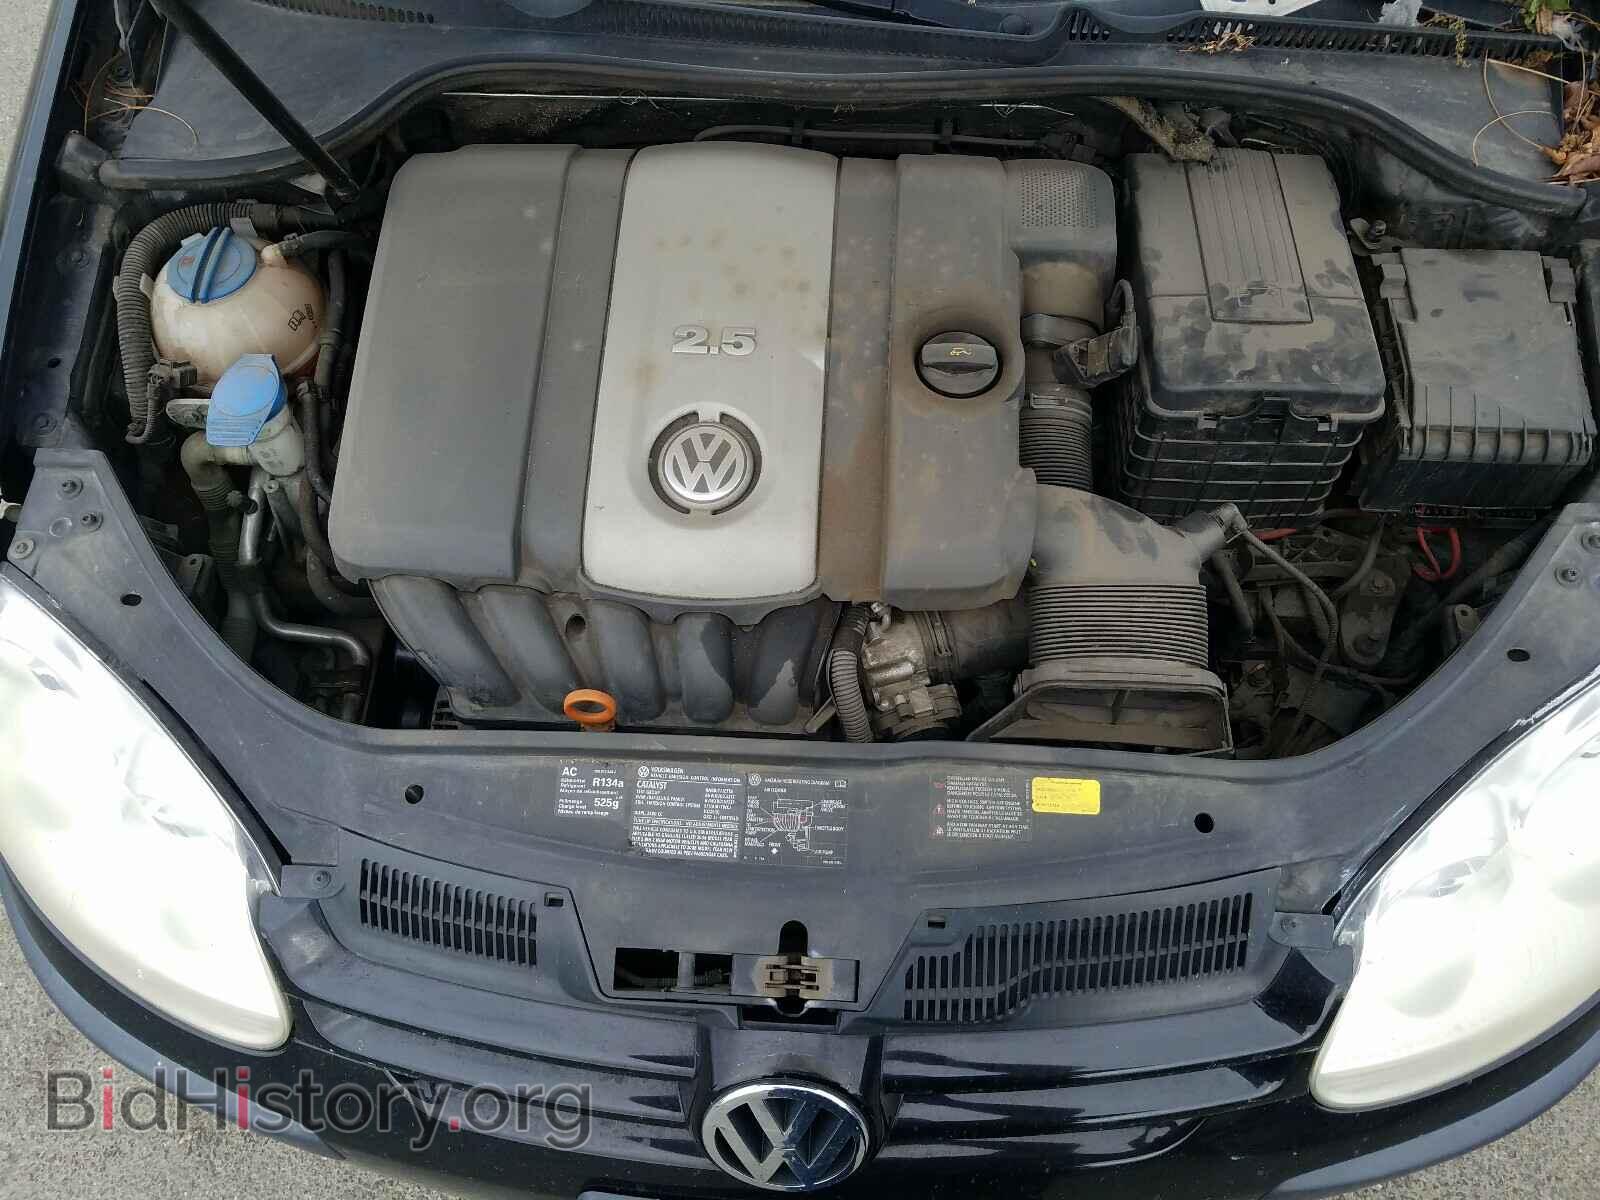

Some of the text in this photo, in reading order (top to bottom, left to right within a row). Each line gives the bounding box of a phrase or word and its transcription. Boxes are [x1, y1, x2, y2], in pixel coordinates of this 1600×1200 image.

[672, 325, 757, 356] 2.5
[561, 767, 578, 776] AC
[592, 777, 624, 788] R134a
[636, 780, 667, 791] CATALYST
[593, 797, 620, 810] 525g
